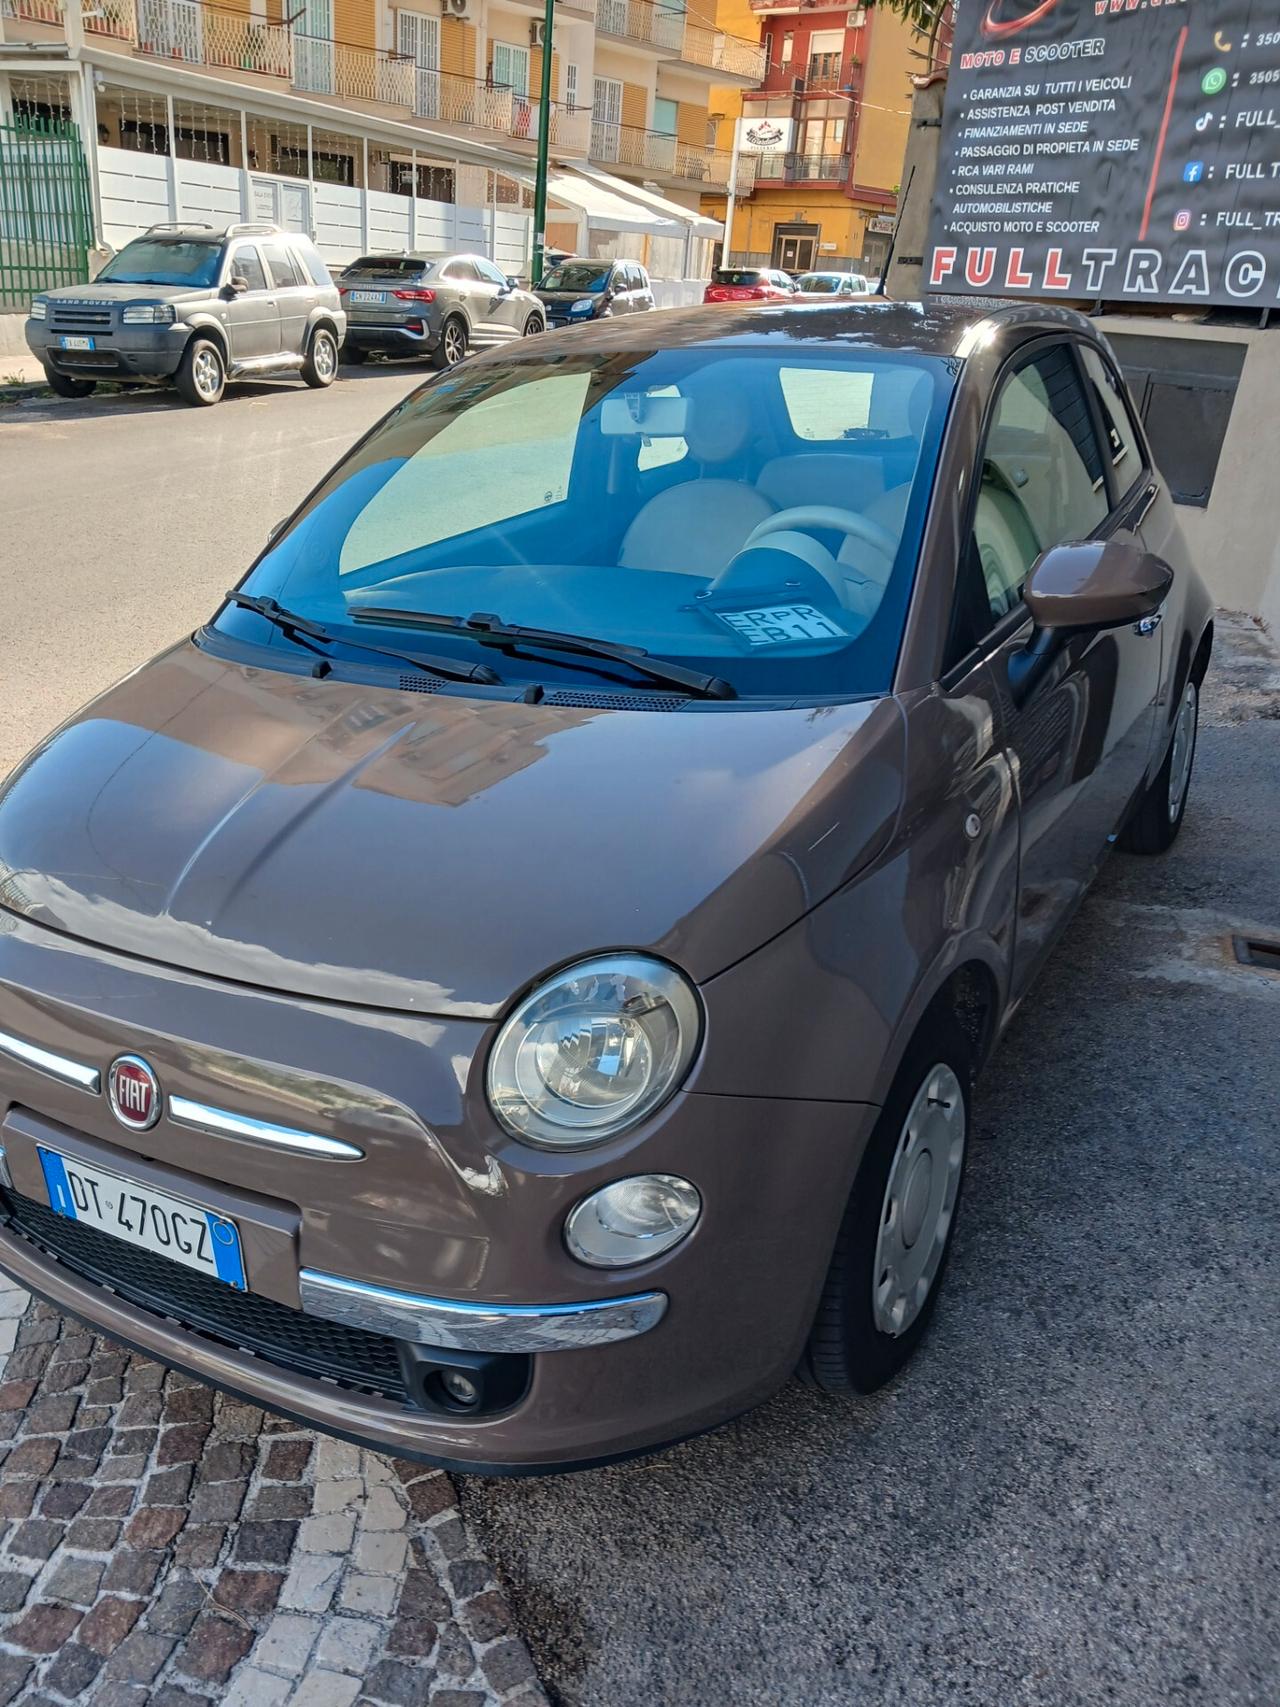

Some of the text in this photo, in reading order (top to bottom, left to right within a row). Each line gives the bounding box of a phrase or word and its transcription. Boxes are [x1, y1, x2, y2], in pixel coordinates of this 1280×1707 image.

[960, 38, 1106, 69] MOTO E SCOOTER
[970, 75, 1133, 101] GARANZIA SU TUTTI I VEICOLI
[966, 98, 1116, 121] ASSISTENZA POST VENDITA
[963, 120, 1089, 139] FINANZIAMENTI IN SEDE
[960, 138, 1140, 158] PASSAGGIO DI PROPIETA IN SEDE
[957, 163, 1035, 176] RCA VARI RAMI
[1225, 162, 1265, 179] FULL
[955, 181, 1081, 195] CONSULENZA PRATICHE
[952, 201, 1053, 214] AUTOMOBILISTICHE
[949, 220, 1101, 234] ACQUISTO MOTO E SCOOTER
[929, 246, 1280, 300] FULLTRAC
[118, 1074, 149, 1113] FIAT
[67, 1169, 214, 1265] DT 470GZ
